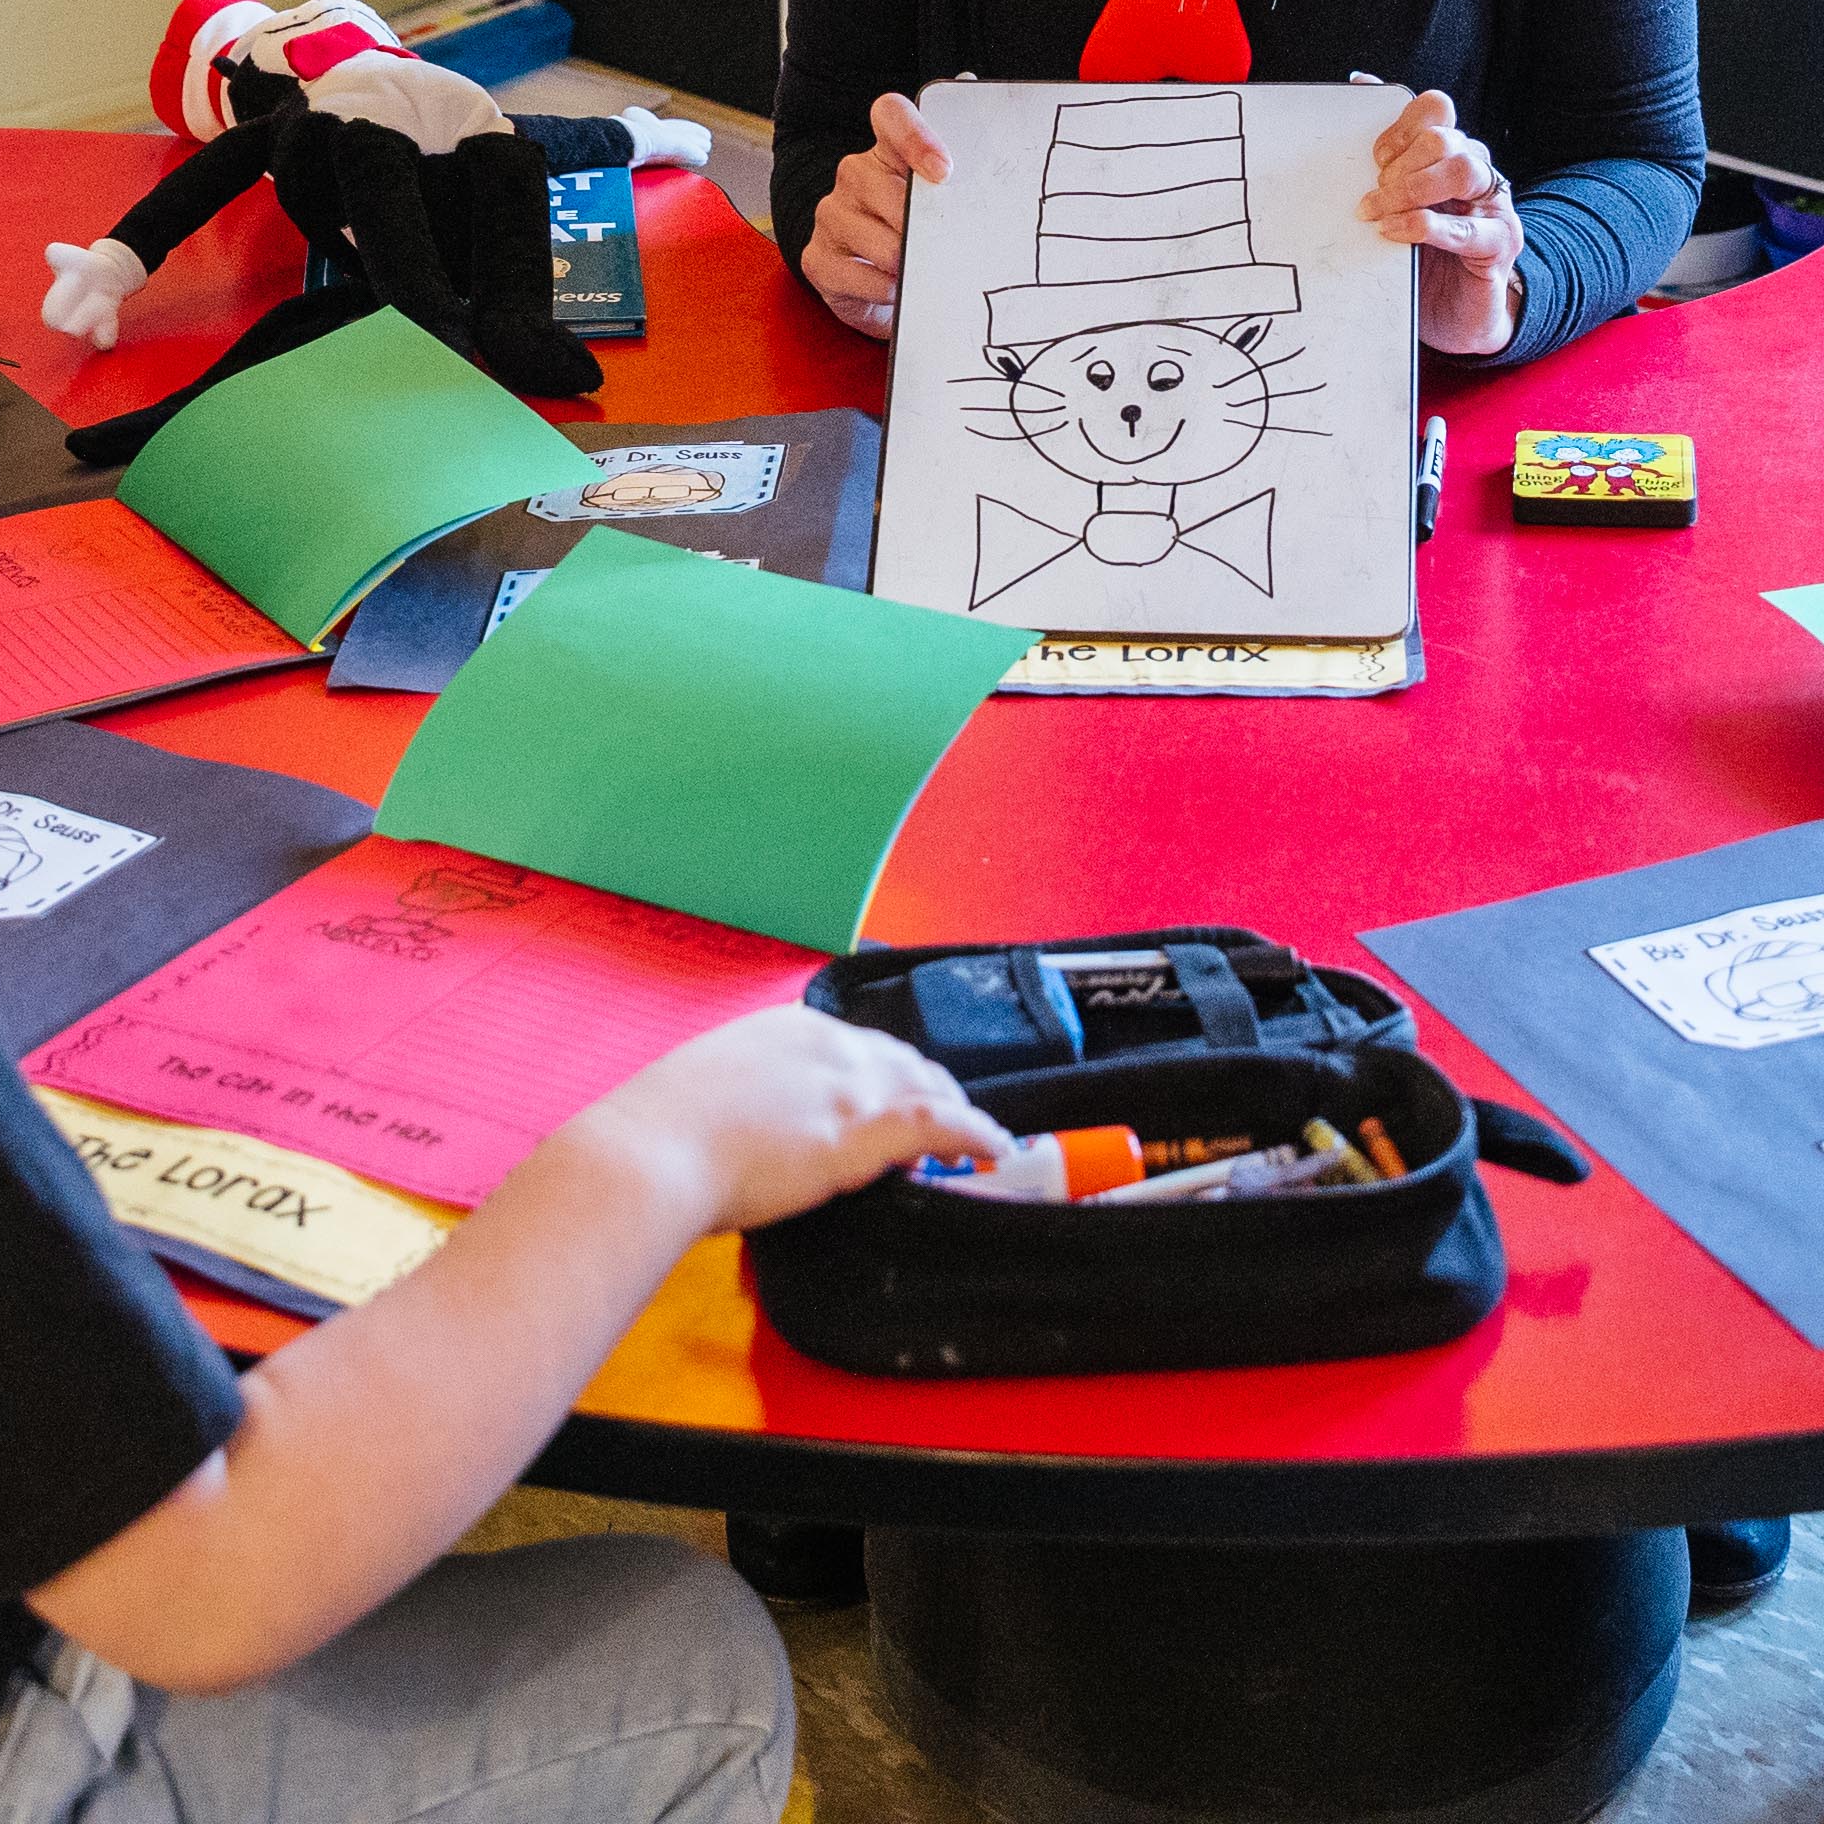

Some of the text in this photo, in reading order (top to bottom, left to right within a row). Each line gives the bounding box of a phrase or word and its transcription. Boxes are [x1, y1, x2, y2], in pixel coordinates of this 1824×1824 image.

[553, 288, 623, 303] euss
[627, 451, 663, 463] Dr.
[676, 449, 743, 461] Seuss
[1516, 473, 1563, 484] Thing
[1122, 643, 1271, 663] Lorax
[33, 813, 101, 844] Seuss
[1642, 939, 1688, 964] By:
[1693, 923, 1750, 951] Dr.
[156, 1153, 332, 1228] Lorax
